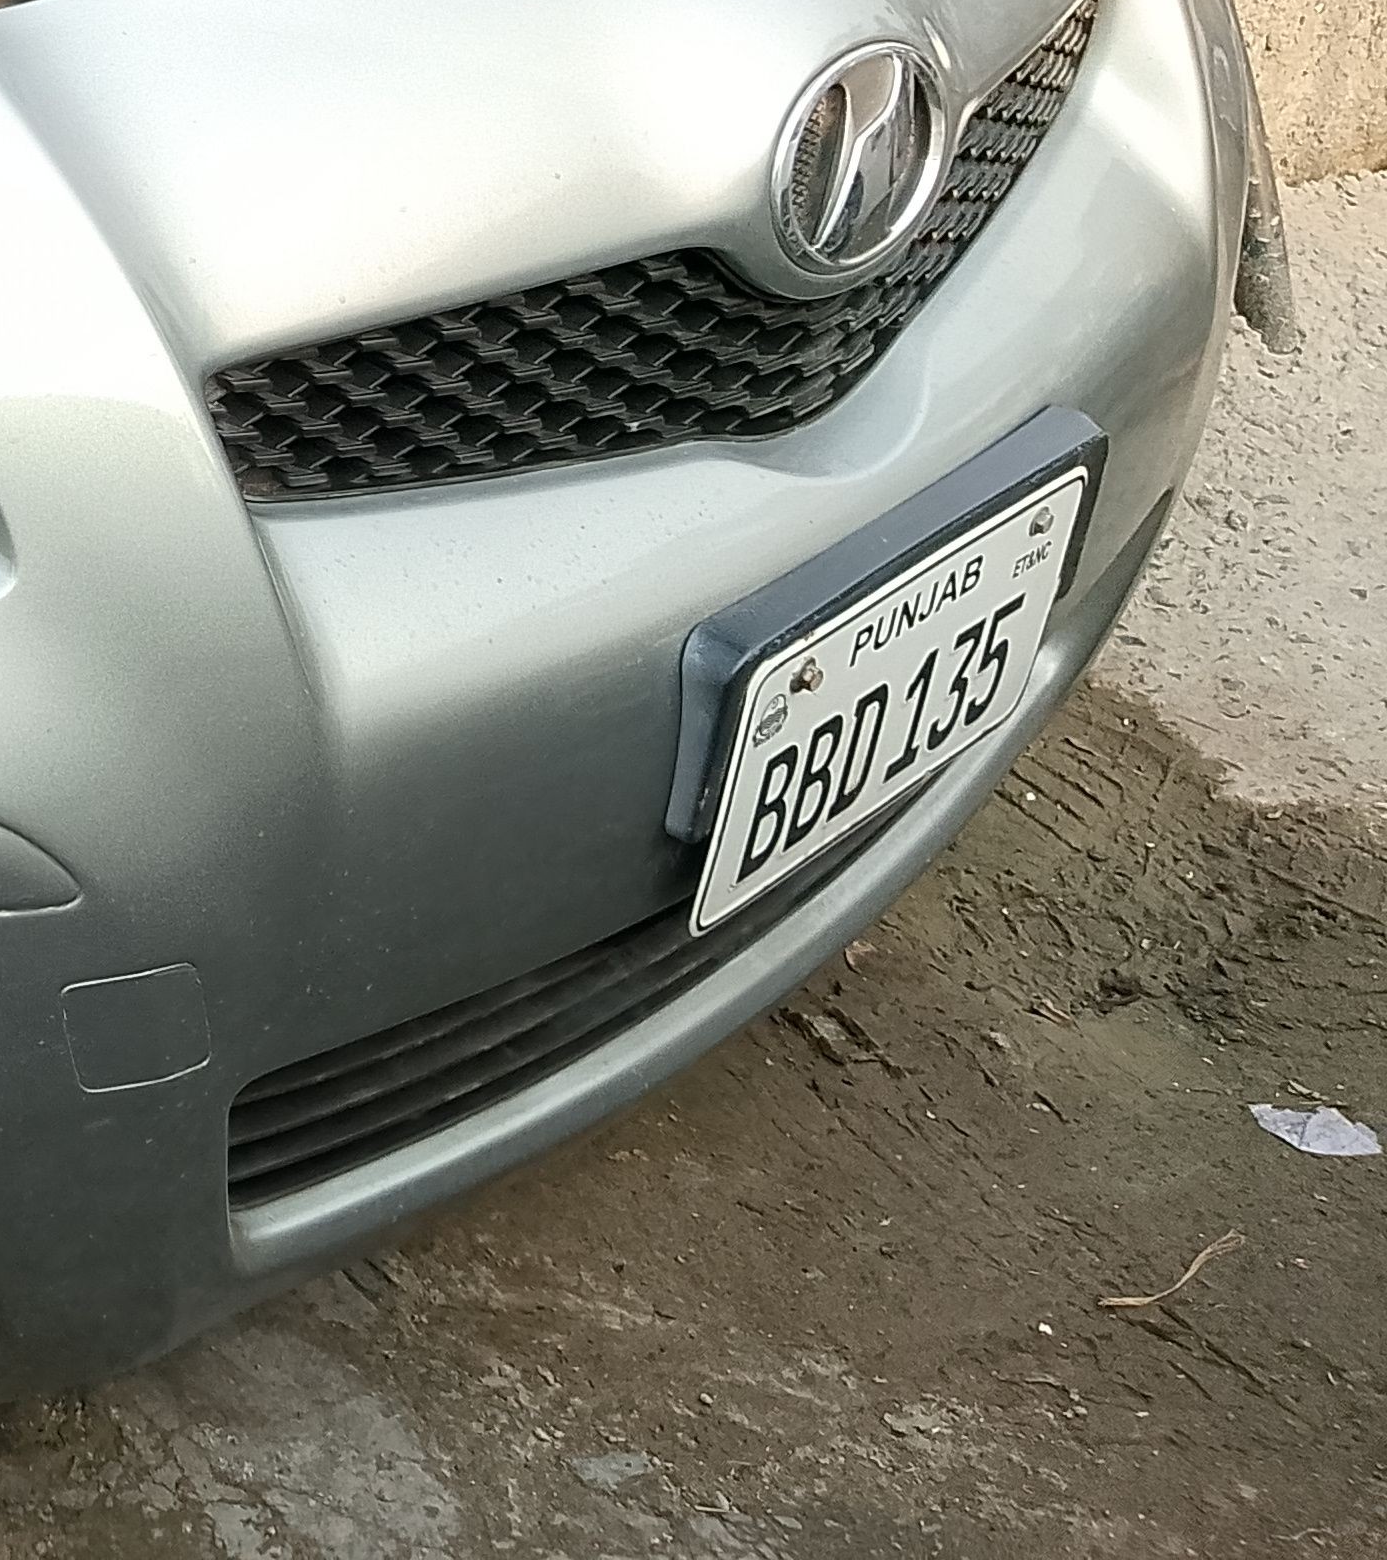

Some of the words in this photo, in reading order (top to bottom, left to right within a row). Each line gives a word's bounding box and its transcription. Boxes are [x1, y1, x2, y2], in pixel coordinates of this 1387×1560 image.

[848, 553, 984, 668] PUNJAB
[735, 682, 890, 885] BBD
[883, 592, 1027, 784] 135
